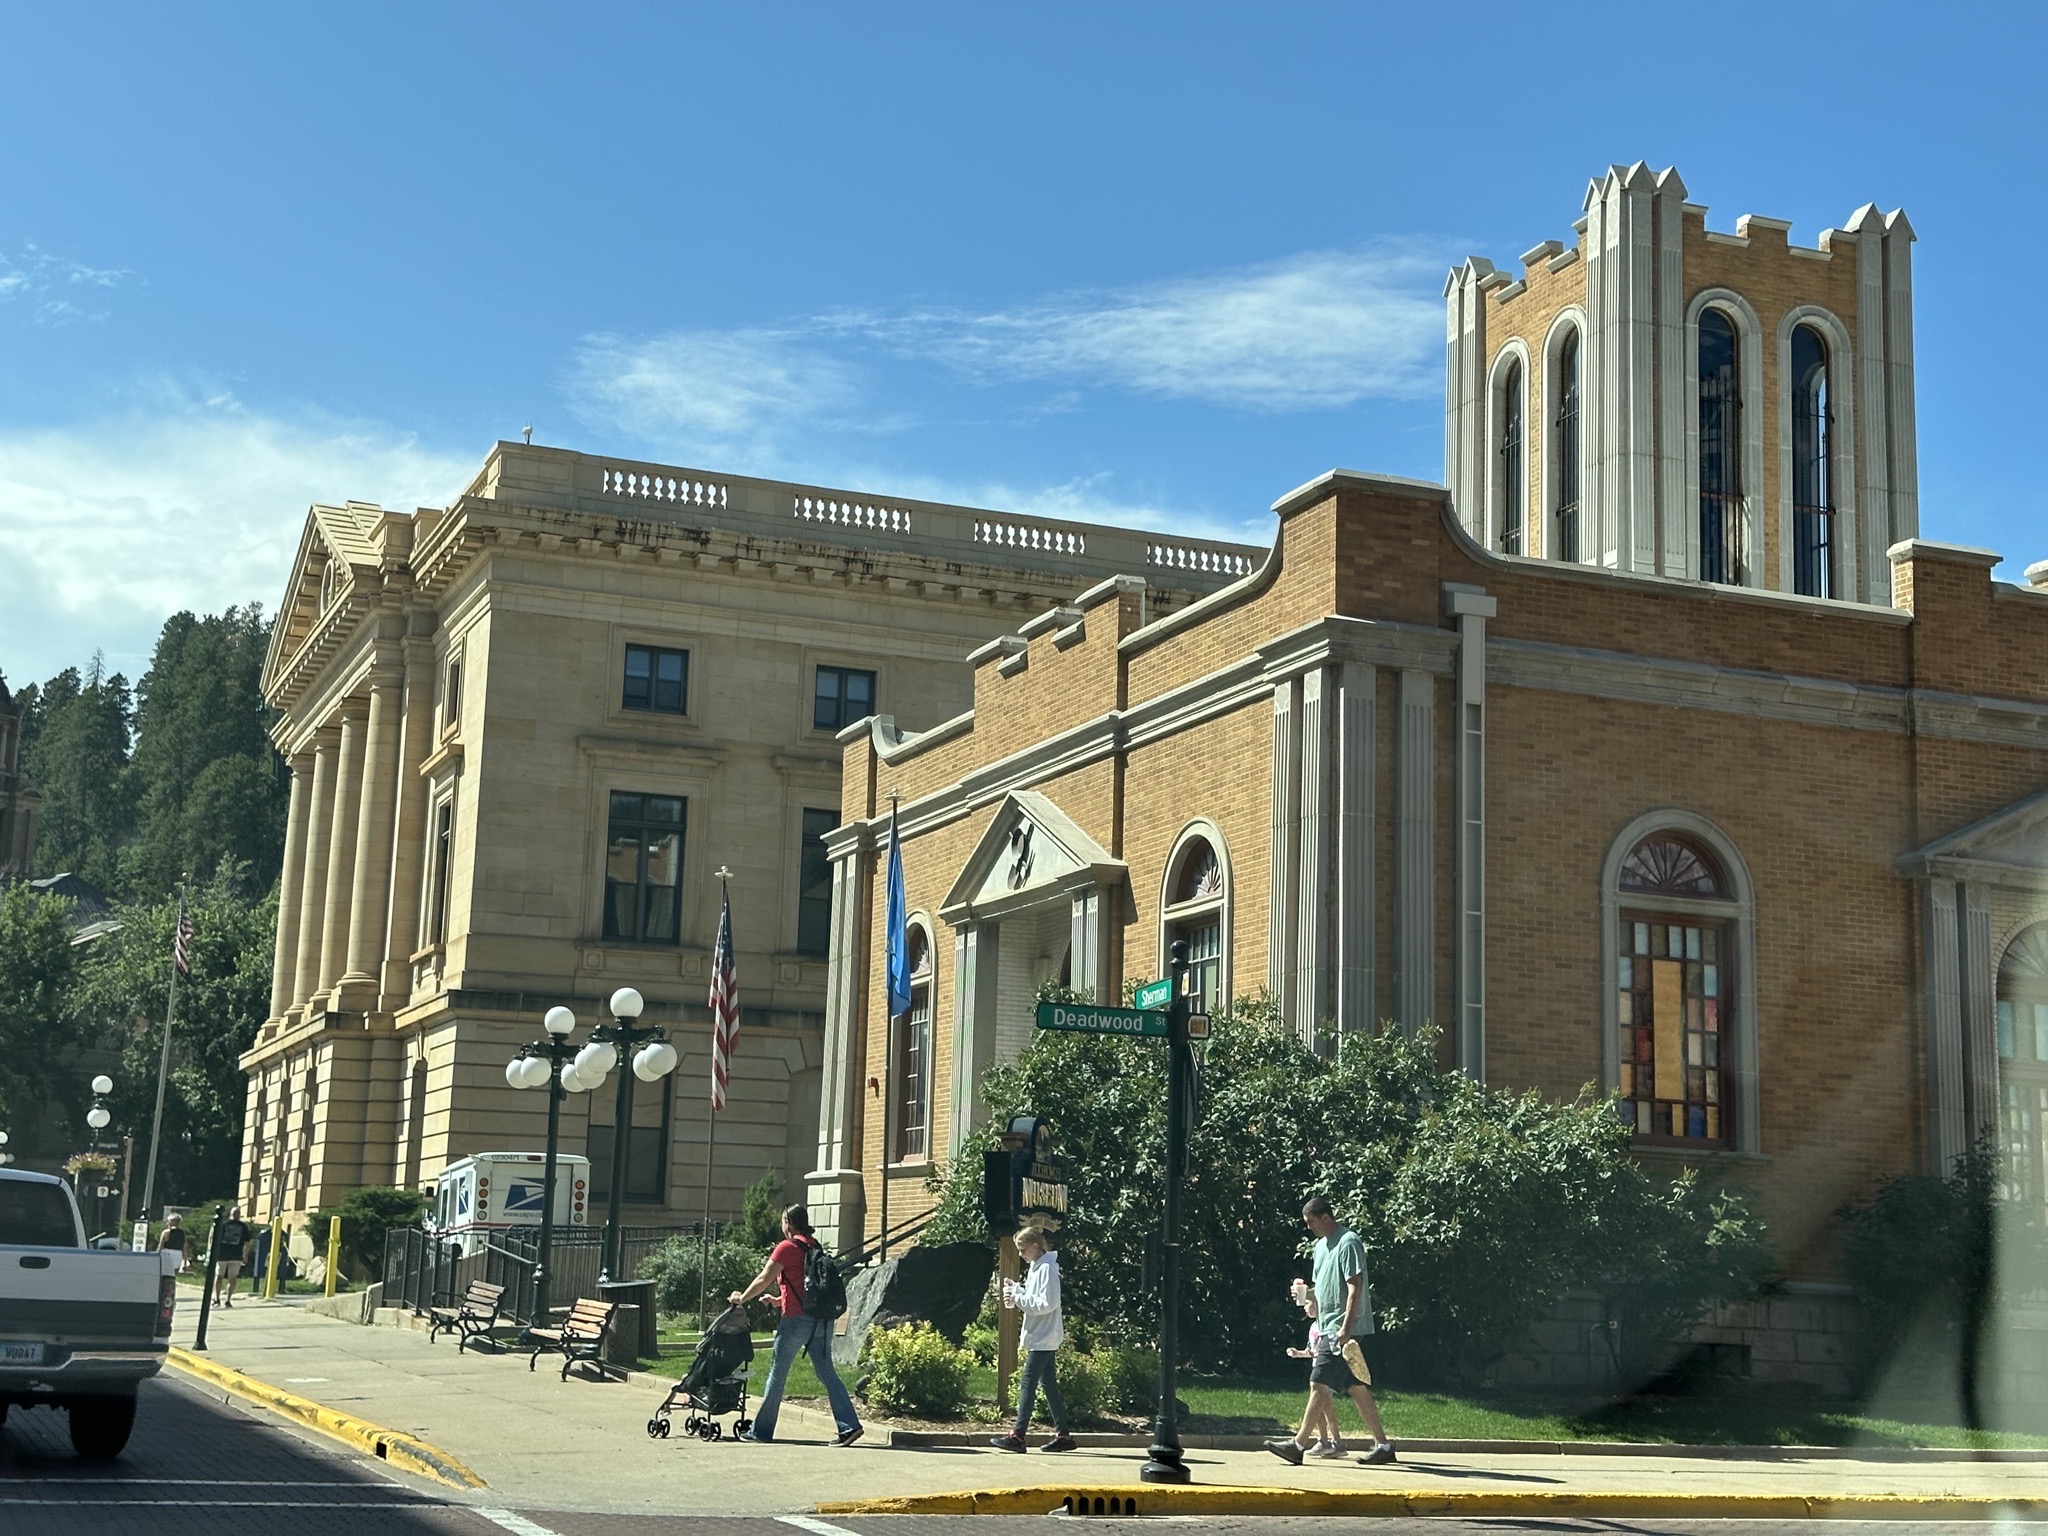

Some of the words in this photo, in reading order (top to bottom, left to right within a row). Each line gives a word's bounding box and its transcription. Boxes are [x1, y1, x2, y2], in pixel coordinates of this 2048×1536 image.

[1141, 986, 1167, 1007] Sherman
[1053, 1008, 1143, 1032] Deadwood
[1155, 1016, 1166, 1026] St
[1022, 1177, 1068, 1213] MUSEUM
